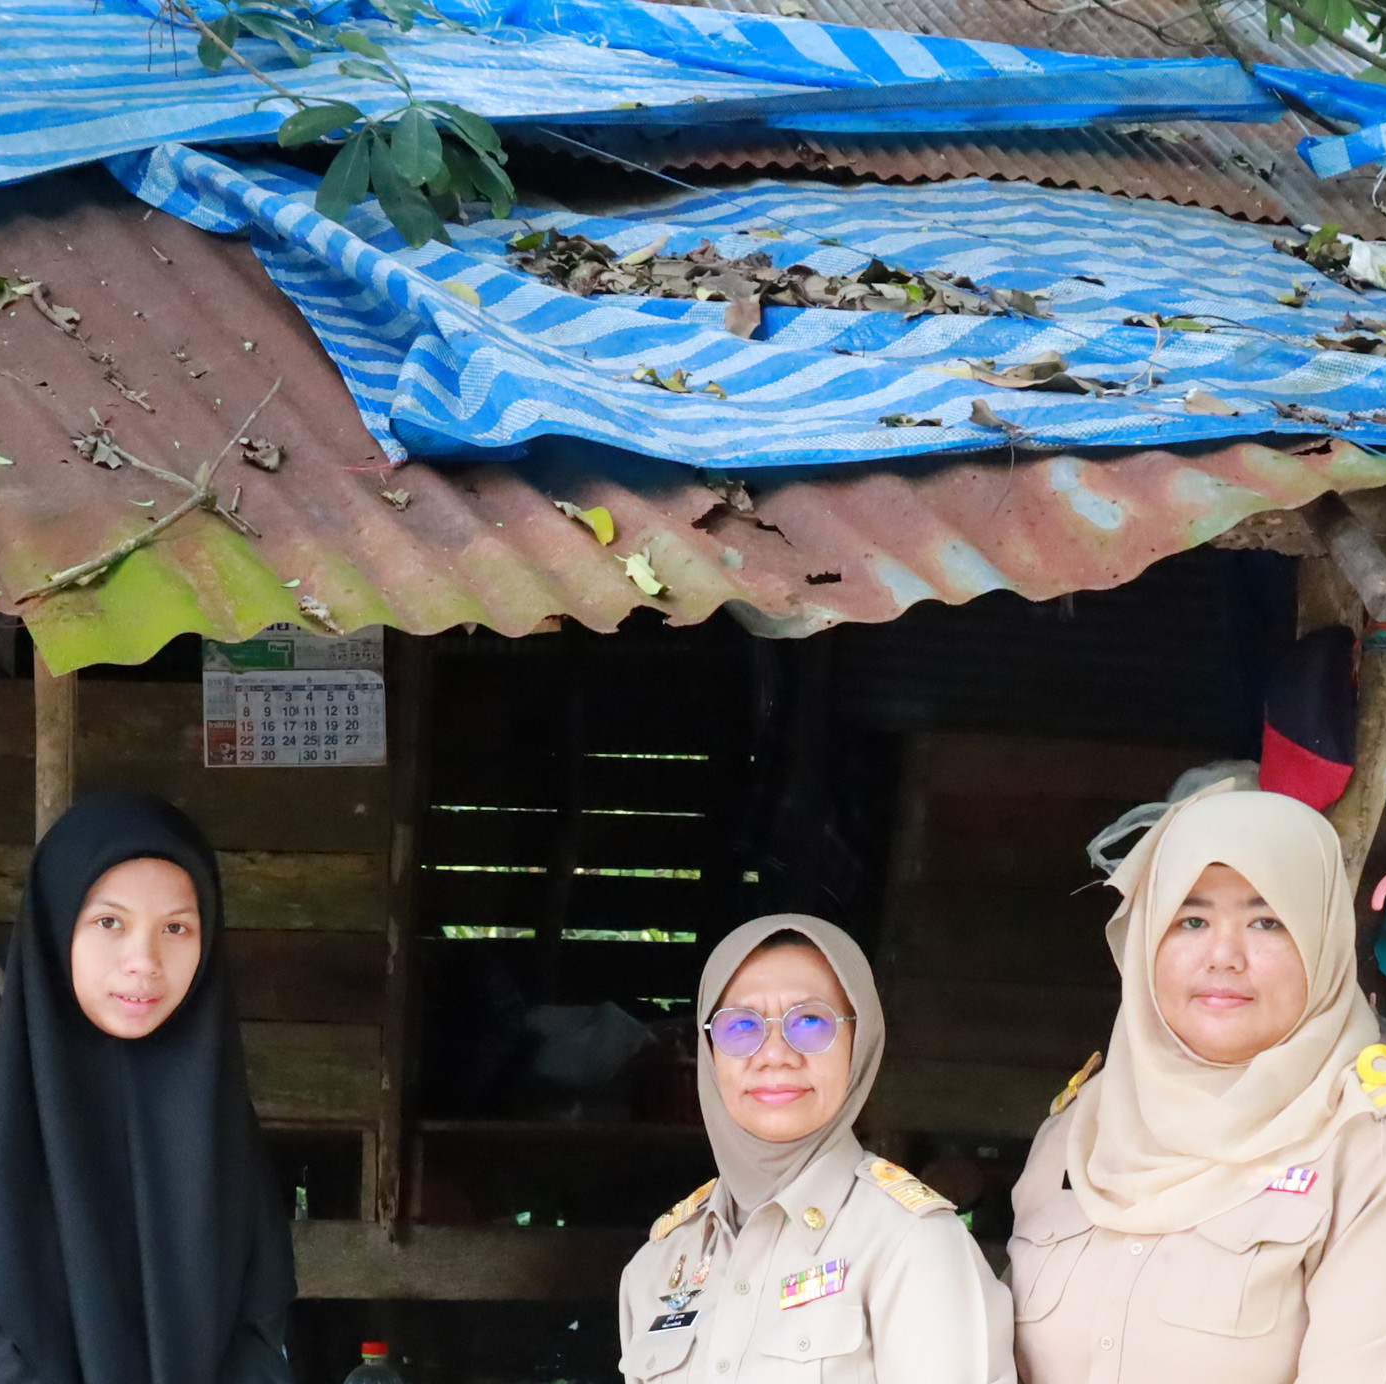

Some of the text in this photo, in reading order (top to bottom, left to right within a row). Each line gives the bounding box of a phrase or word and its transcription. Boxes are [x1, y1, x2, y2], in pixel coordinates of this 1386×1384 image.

[243, 692, 249, 702] 1
[264, 692, 271, 702] 2
[285, 692, 293, 702] 3
[306, 691, 313, 702] 4
[327, 691, 334, 702] 5
[348, 690, 355, 701] 6
[243, 706, 250, 717] 8
[264, 706, 271, 717] 9
[283, 706, 296, 717] 10
[304, 706, 315, 716] 11
[324, 706, 338, 716] 12
[345, 705, 359, 716] 13
[241, 721, 254, 732] 15
[261, 721, 275, 731] 16
[283, 721, 296, 731] 17
[304, 721, 317, 731] 18
[325, 721, 338, 731] 19
[345, 720, 359, 730] 20
[240, 736, 254, 746] 22
[261, 736, 275, 746] 23
[282, 736, 296, 746] 24
[303, 735, 317, 746] 25
[324, 735, 338, 745] 26
[345, 735, 359, 745] 27
[240, 750, 337, 761] 29 30 30 31
